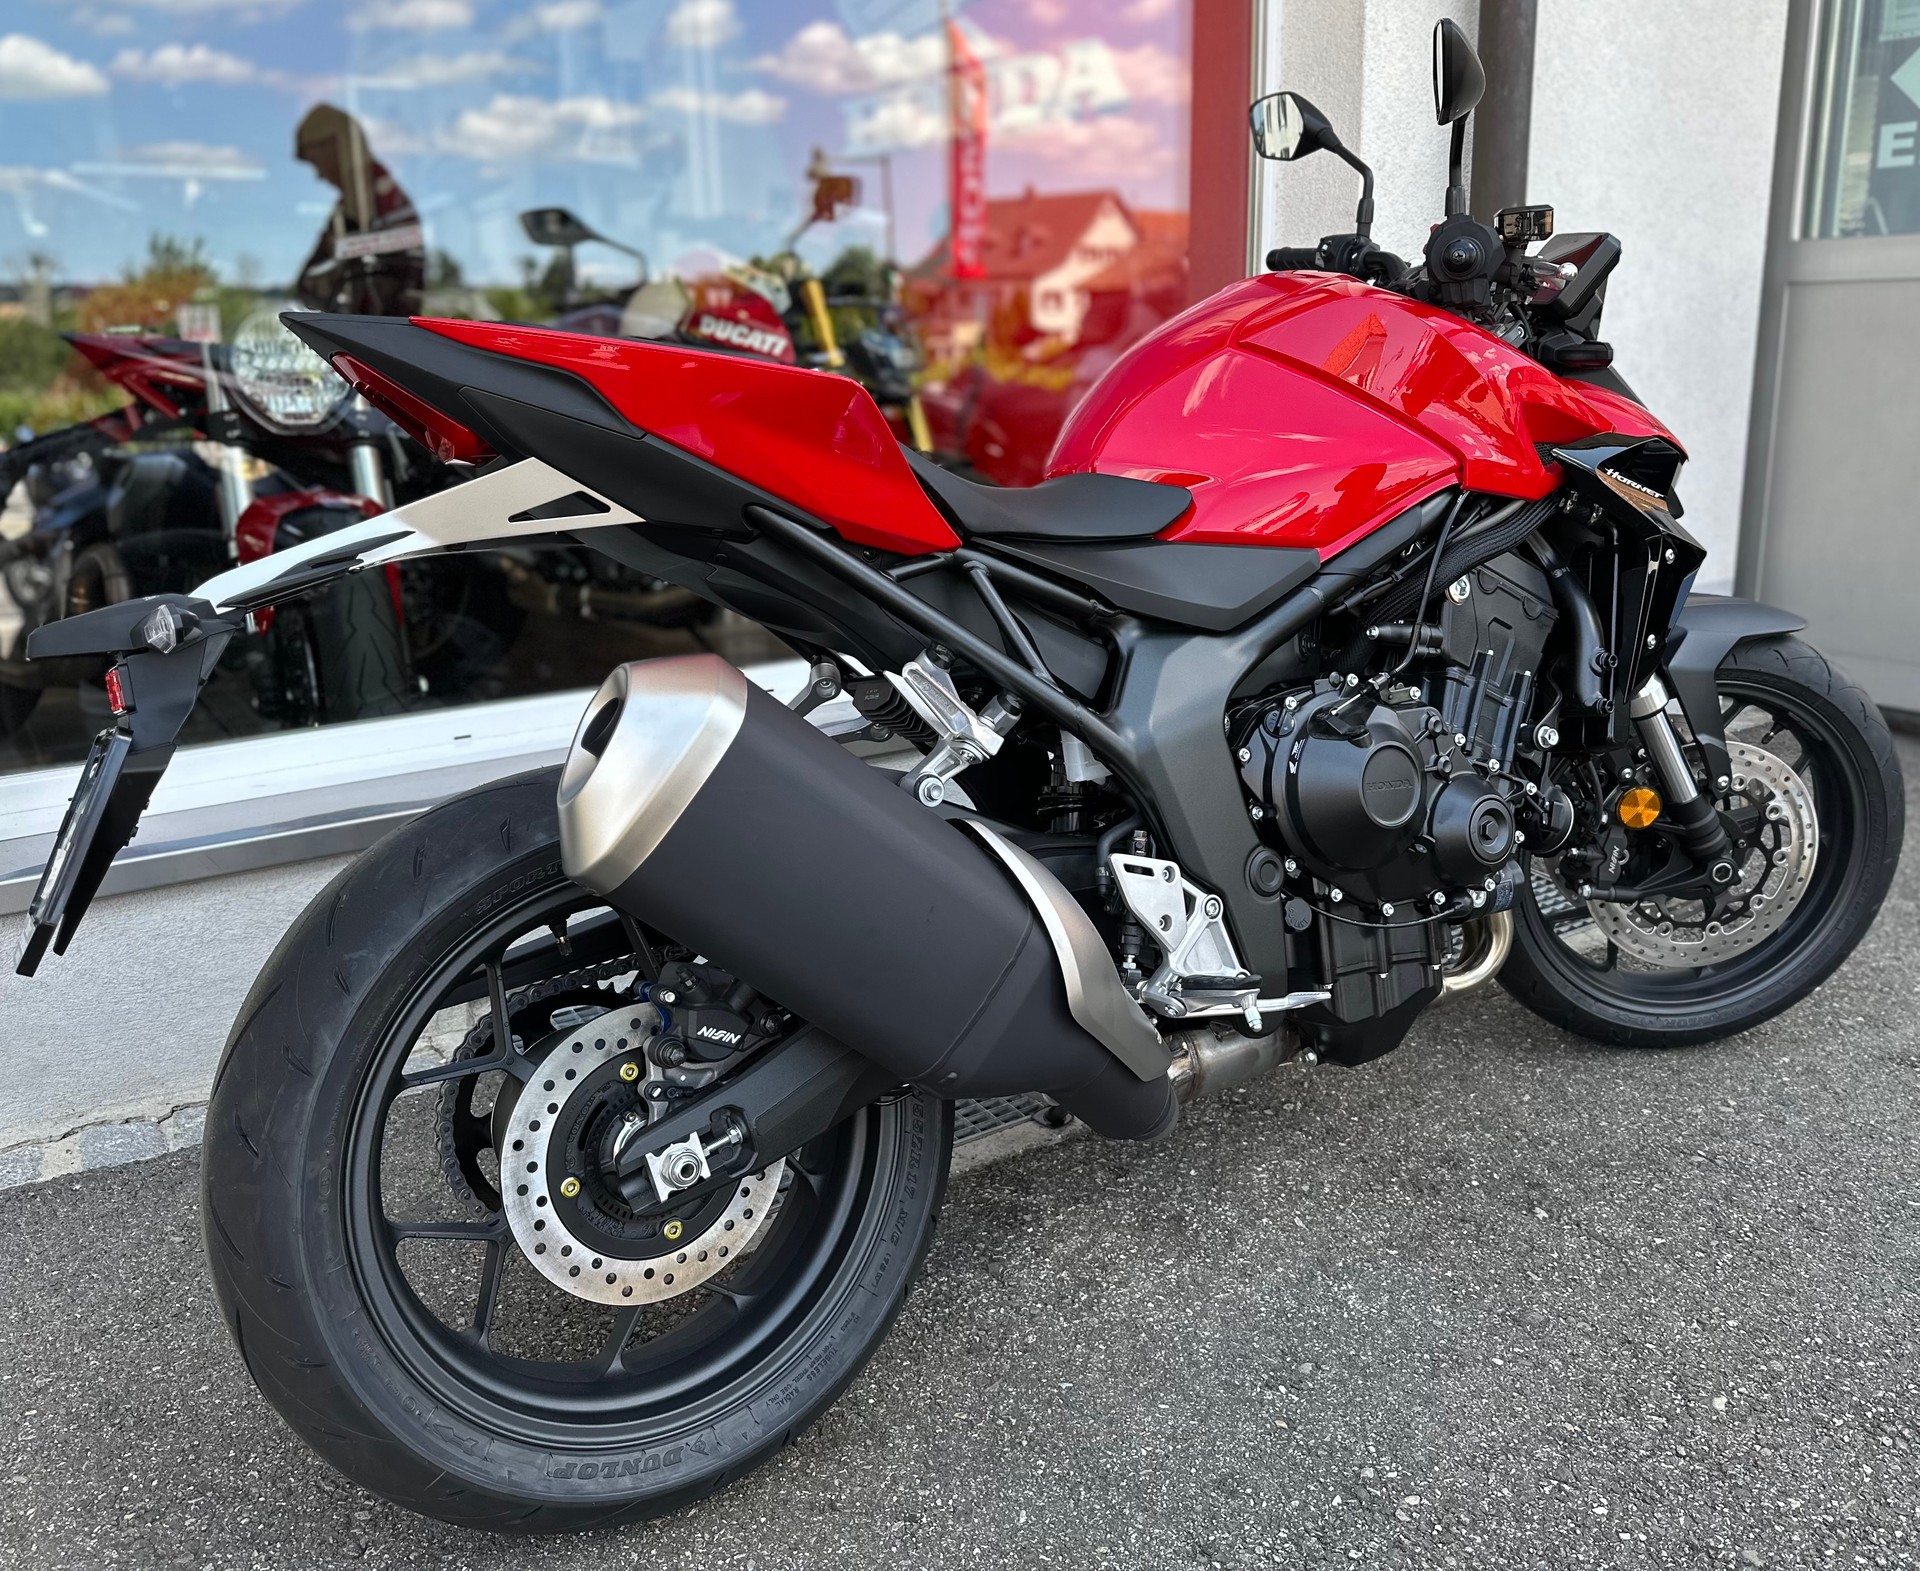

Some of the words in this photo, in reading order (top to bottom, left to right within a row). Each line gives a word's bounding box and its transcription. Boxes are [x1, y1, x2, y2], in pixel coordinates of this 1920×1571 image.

[1877, 121, 1920, 169] E
[699, 313, 787, 357] DUCATI
[1365, 778, 1414, 793] HONDA
[552, 1445, 686, 1480] DUNLOP
